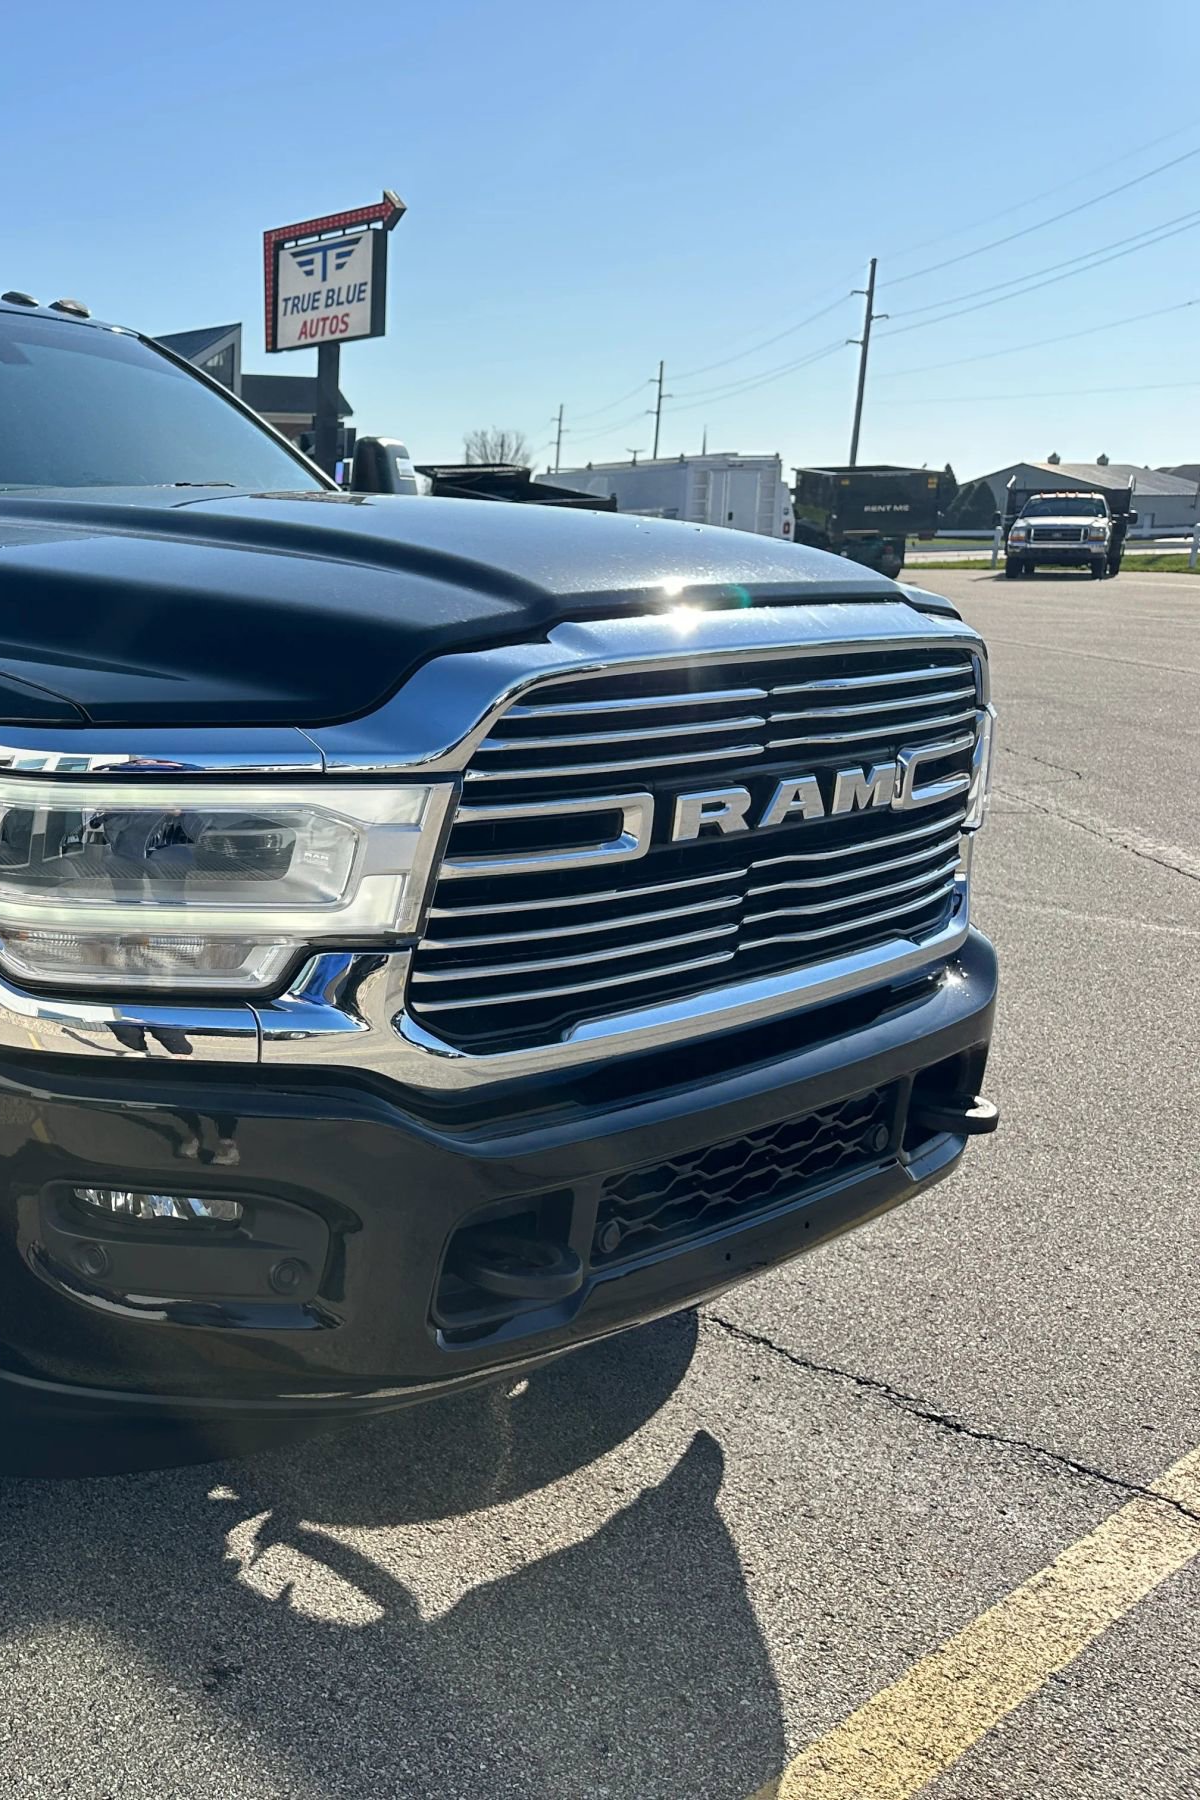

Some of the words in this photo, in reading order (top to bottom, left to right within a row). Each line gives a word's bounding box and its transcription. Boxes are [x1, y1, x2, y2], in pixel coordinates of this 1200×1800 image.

[282, 290, 322, 317] TRUE
[324, 281, 368, 310] BLUE
[297, 312, 351, 341] AUTOS
[863, 504, 892, 513] RENT
[893, 503, 910, 512] ME
[671, 760, 897, 843] RAM
